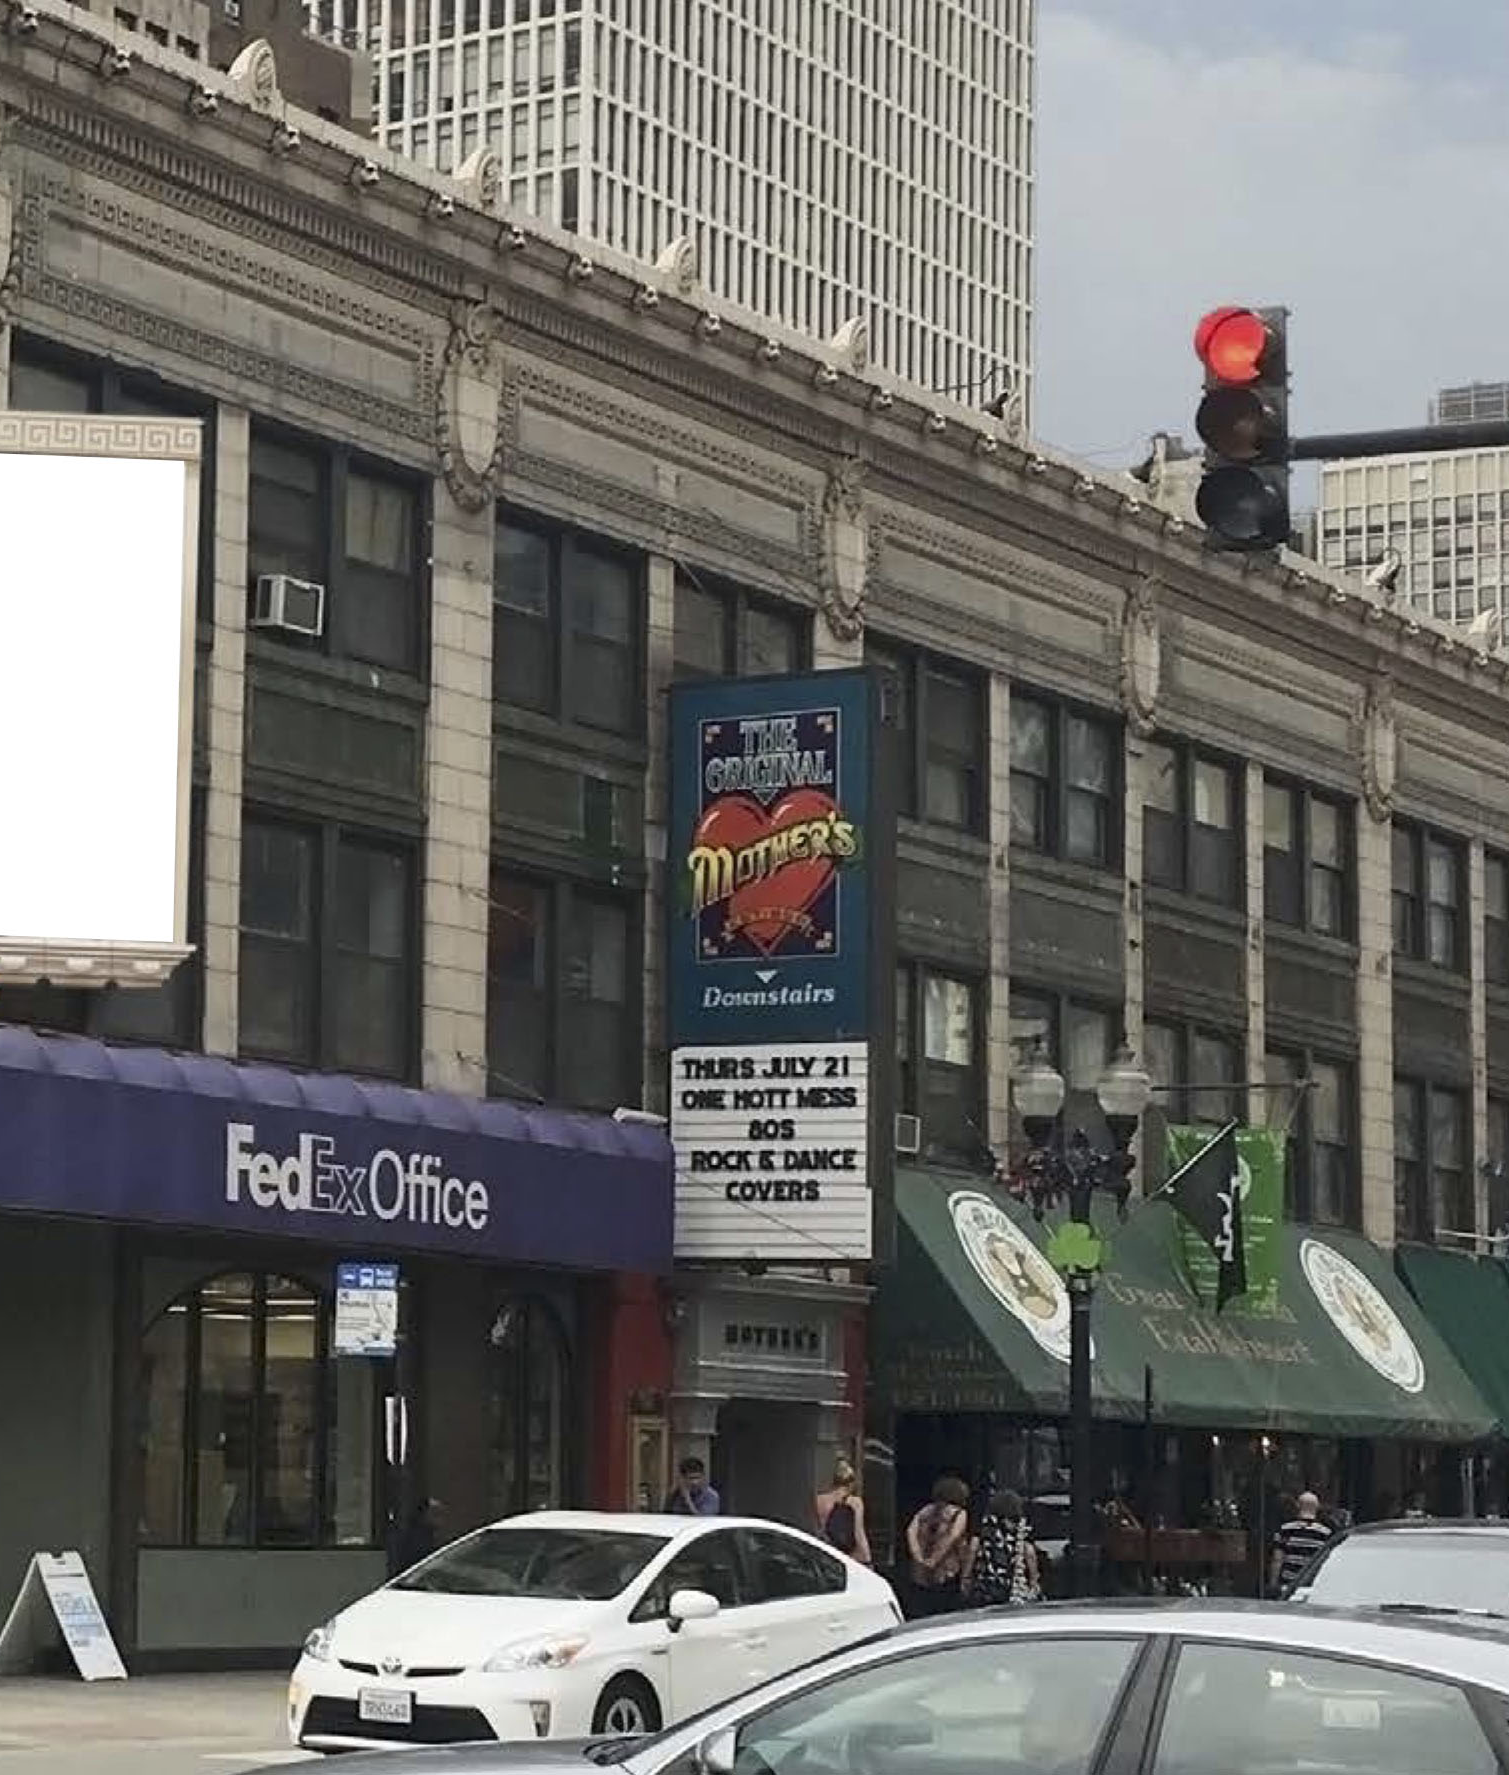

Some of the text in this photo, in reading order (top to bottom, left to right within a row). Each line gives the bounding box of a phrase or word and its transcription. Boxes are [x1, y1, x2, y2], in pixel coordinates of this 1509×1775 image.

[739, 716, 798, 755] THE
[704, 750, 832, 793] ORIGINAL
[702, 983, 836, 1009] Downstairs
[682, 1055, 849, 1080] THURS JULY 21
[681, 1087, 857, 1110] ONE HOTT MESS
[691, 1149, 857, 1172] ROCK & DANCE
[226, 1122, 489, 1230] FedEx Office
[725, 1179, 820, 1202] COVERS
